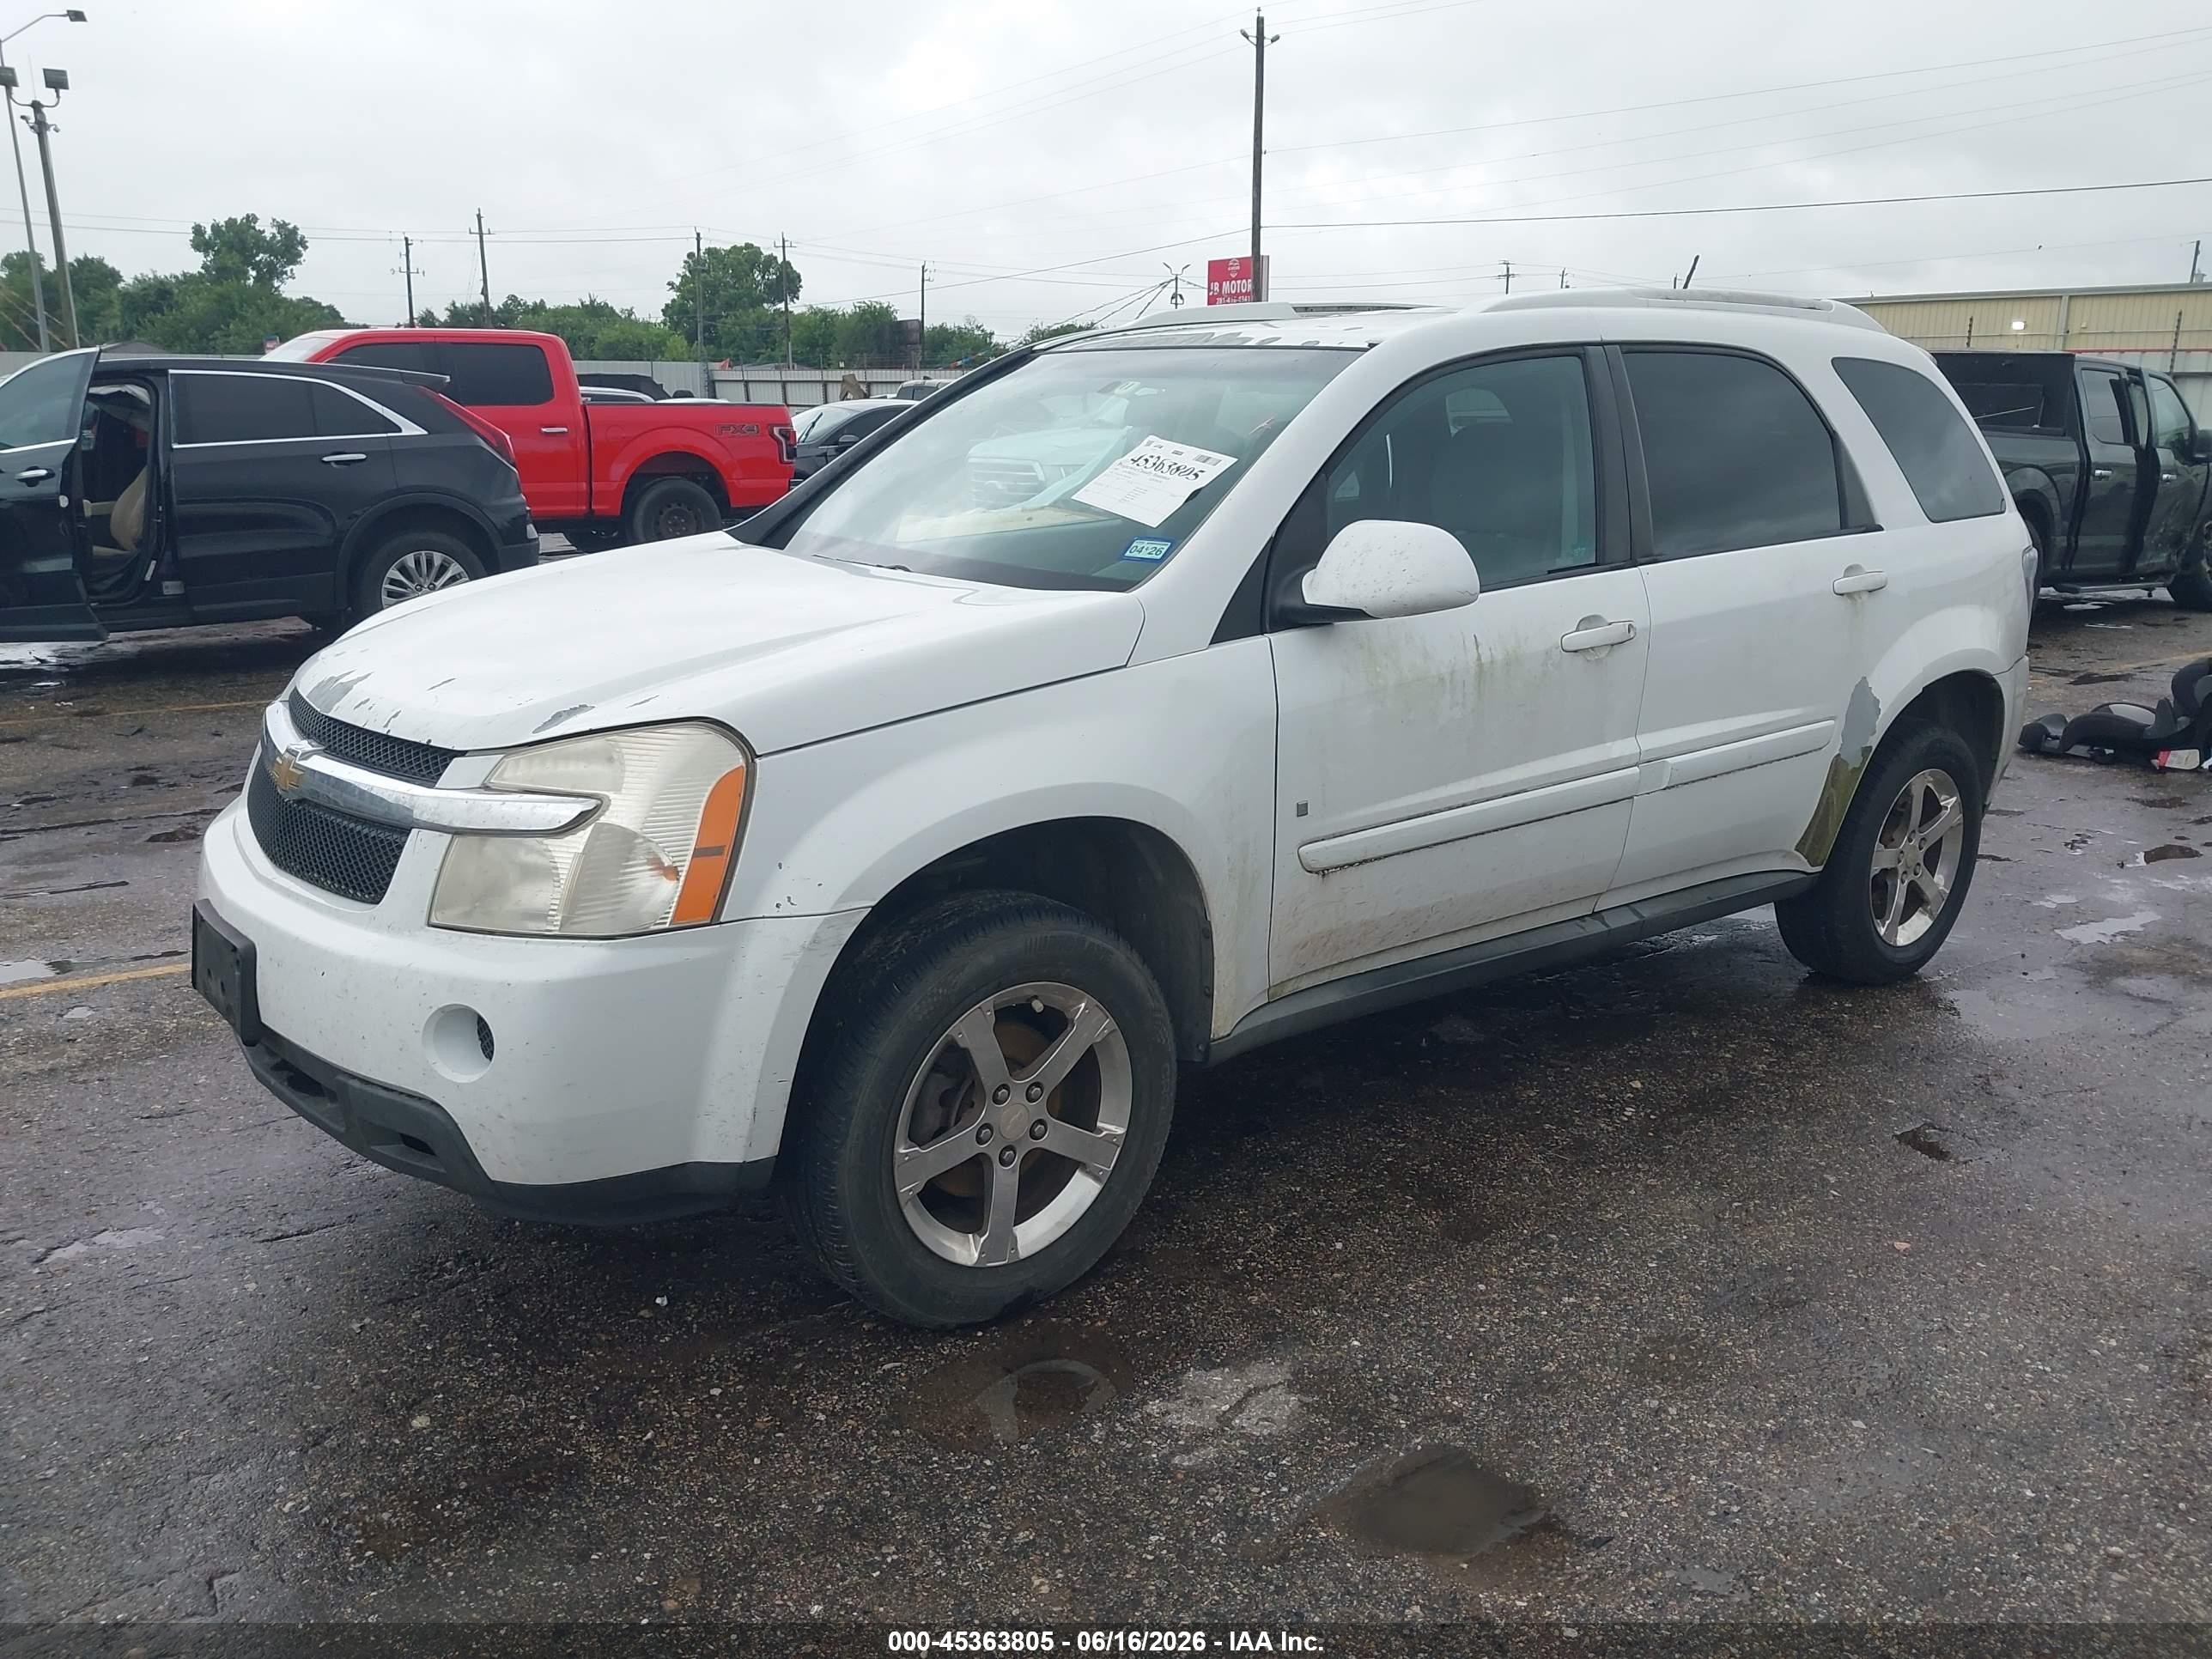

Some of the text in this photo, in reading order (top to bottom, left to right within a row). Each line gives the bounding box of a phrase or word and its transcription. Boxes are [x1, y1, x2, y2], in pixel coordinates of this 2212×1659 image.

[715, 423, 760, 435] FX4
[1130, 453, 1206, 481] 45363805
[1129, 545, 1164, 556] 04 26
